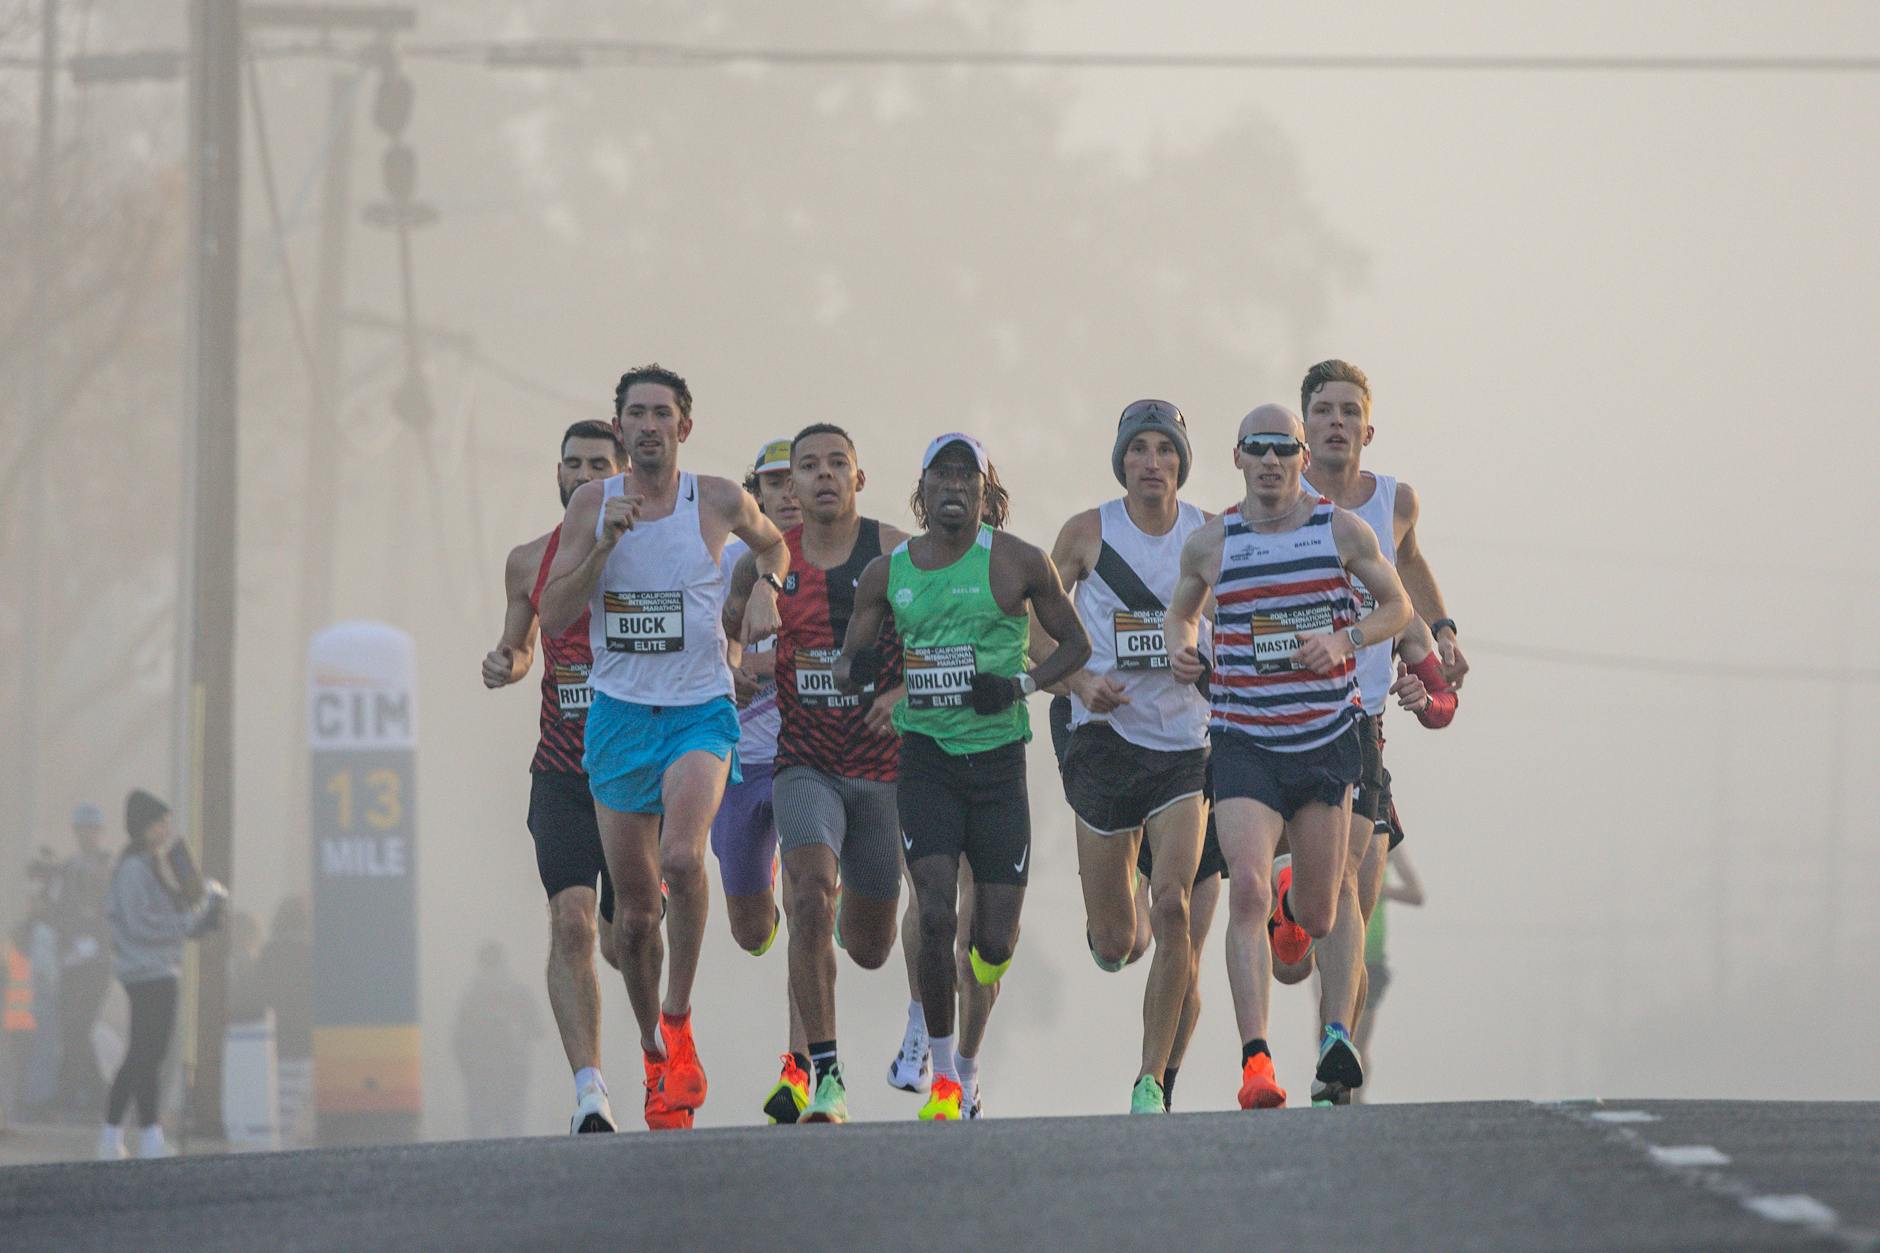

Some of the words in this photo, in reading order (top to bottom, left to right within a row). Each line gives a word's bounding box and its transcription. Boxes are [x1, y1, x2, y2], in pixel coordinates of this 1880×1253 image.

[618, 592, 636, 600] 2024
[641, 591, 681, 600] CALIFORNIA
[1292, 605, 1331, 618] CALIFORNIA
[618, 616, 667, 635] BUCK
[1280, 612, 1331, 626] INTERNATIONAL
[1295, 618, 1332, 631] MARATHON
[634, 640, 667, 651] ELITE
[1127, 634, 1167, 652] CRO
[934, 644, 973, 656] CALIFORNIA
[924, 652, 974, 662] INTERNATIONAL
[936, 658, 975, 668] MARATHON
[1150, 656, 1171, 668] ELI
[801, 674, 838, 690] JOR
[827, 694, 859, 708] ELITE
[932, 694, 963, 707] ELITE
[315, 691, 410, 738] CIM
[326, 767, 404, 831] 13
[320, 836, 405, 877] MILE
